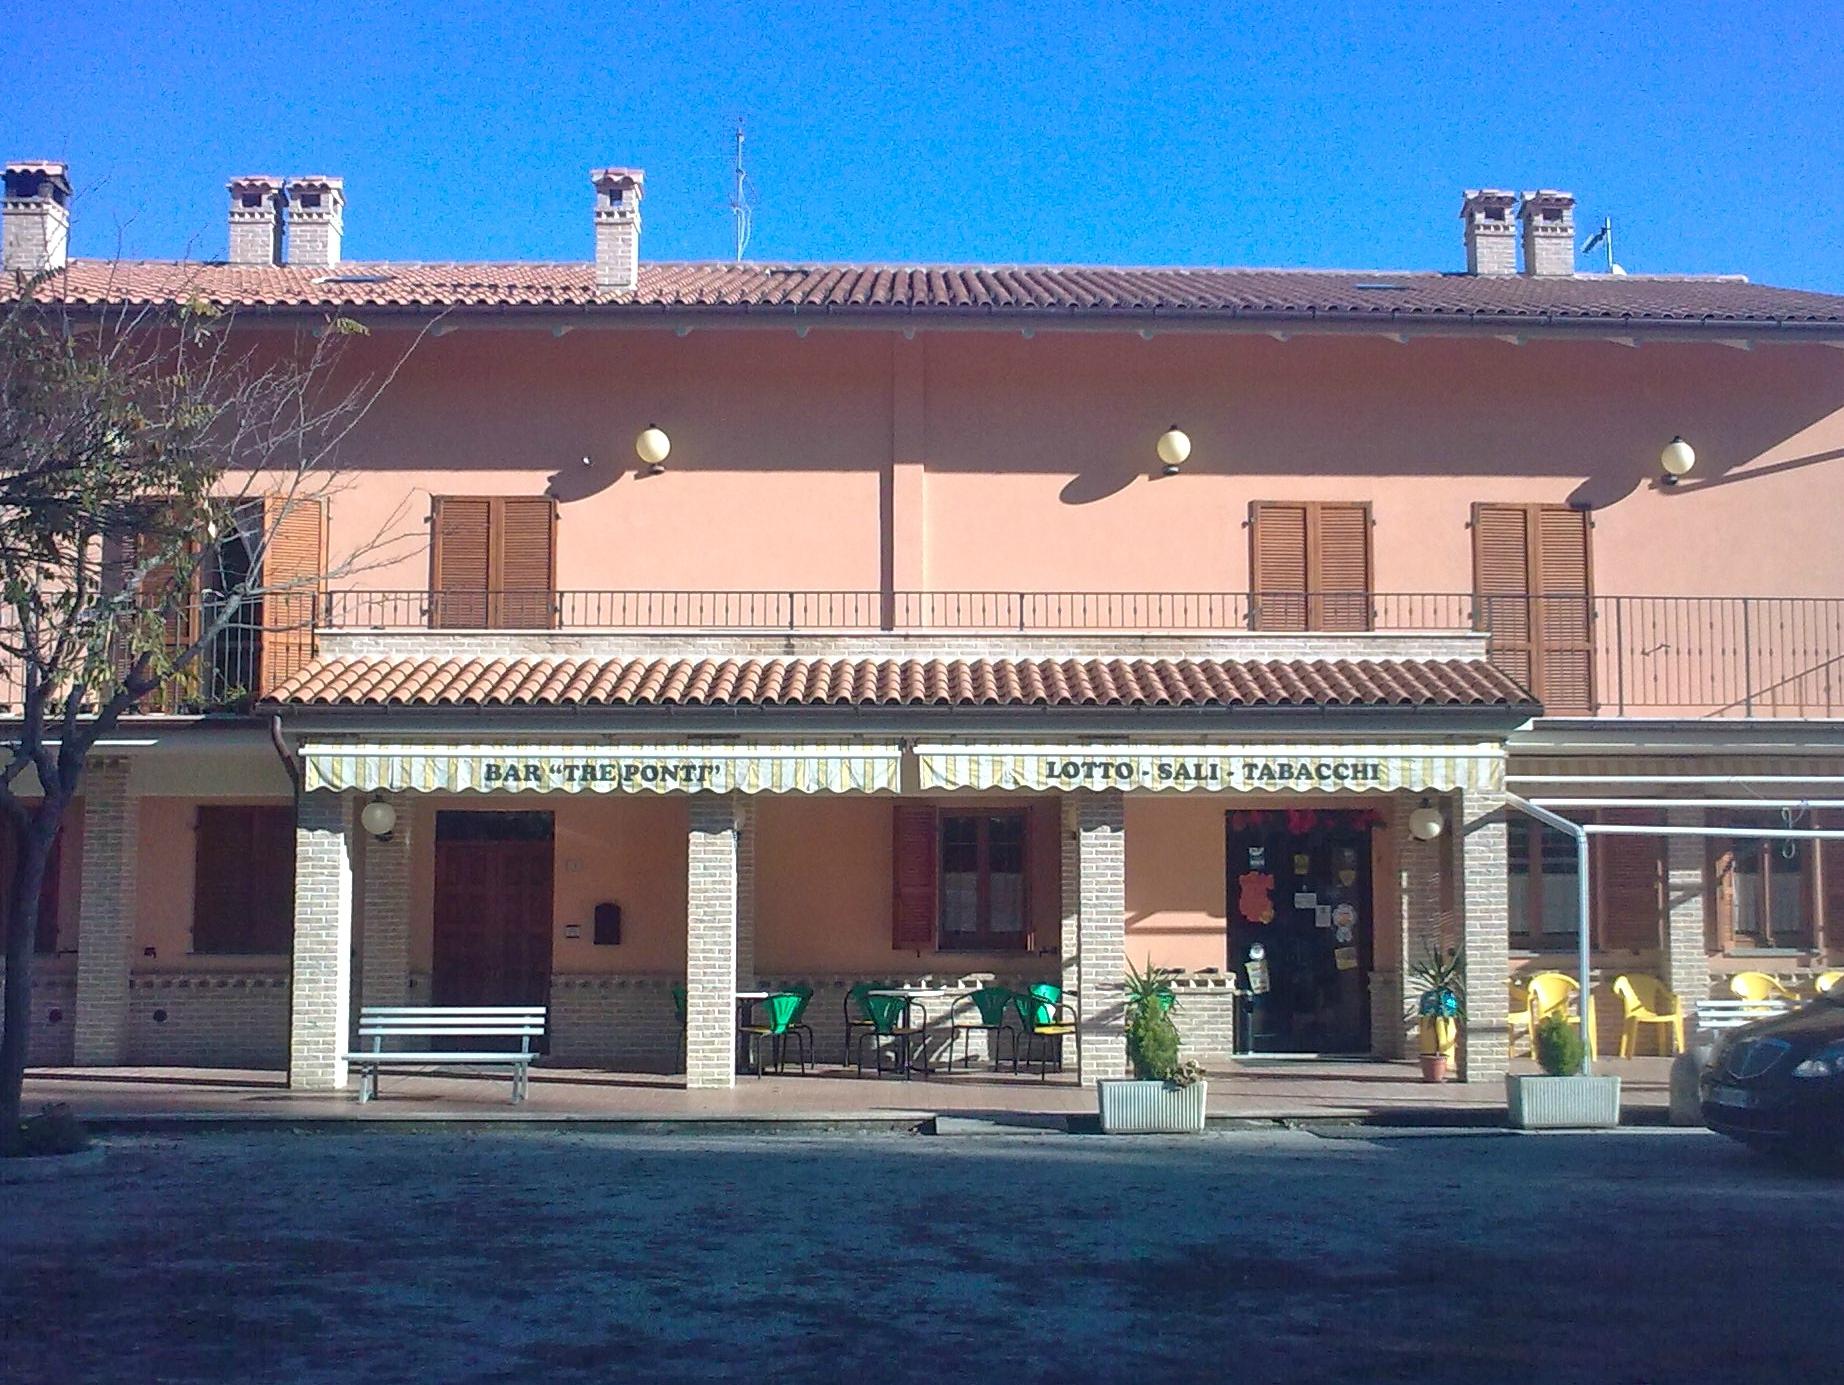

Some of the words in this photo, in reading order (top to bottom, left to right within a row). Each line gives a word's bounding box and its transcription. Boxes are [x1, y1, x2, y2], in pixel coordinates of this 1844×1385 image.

[485, 763, 541, 782] BAR
[1046, 761, 1134, 779] LOTTO
[1158, 763, 1219, 780] SALI
[1242, 763, 1379, 780] TABACCHI
